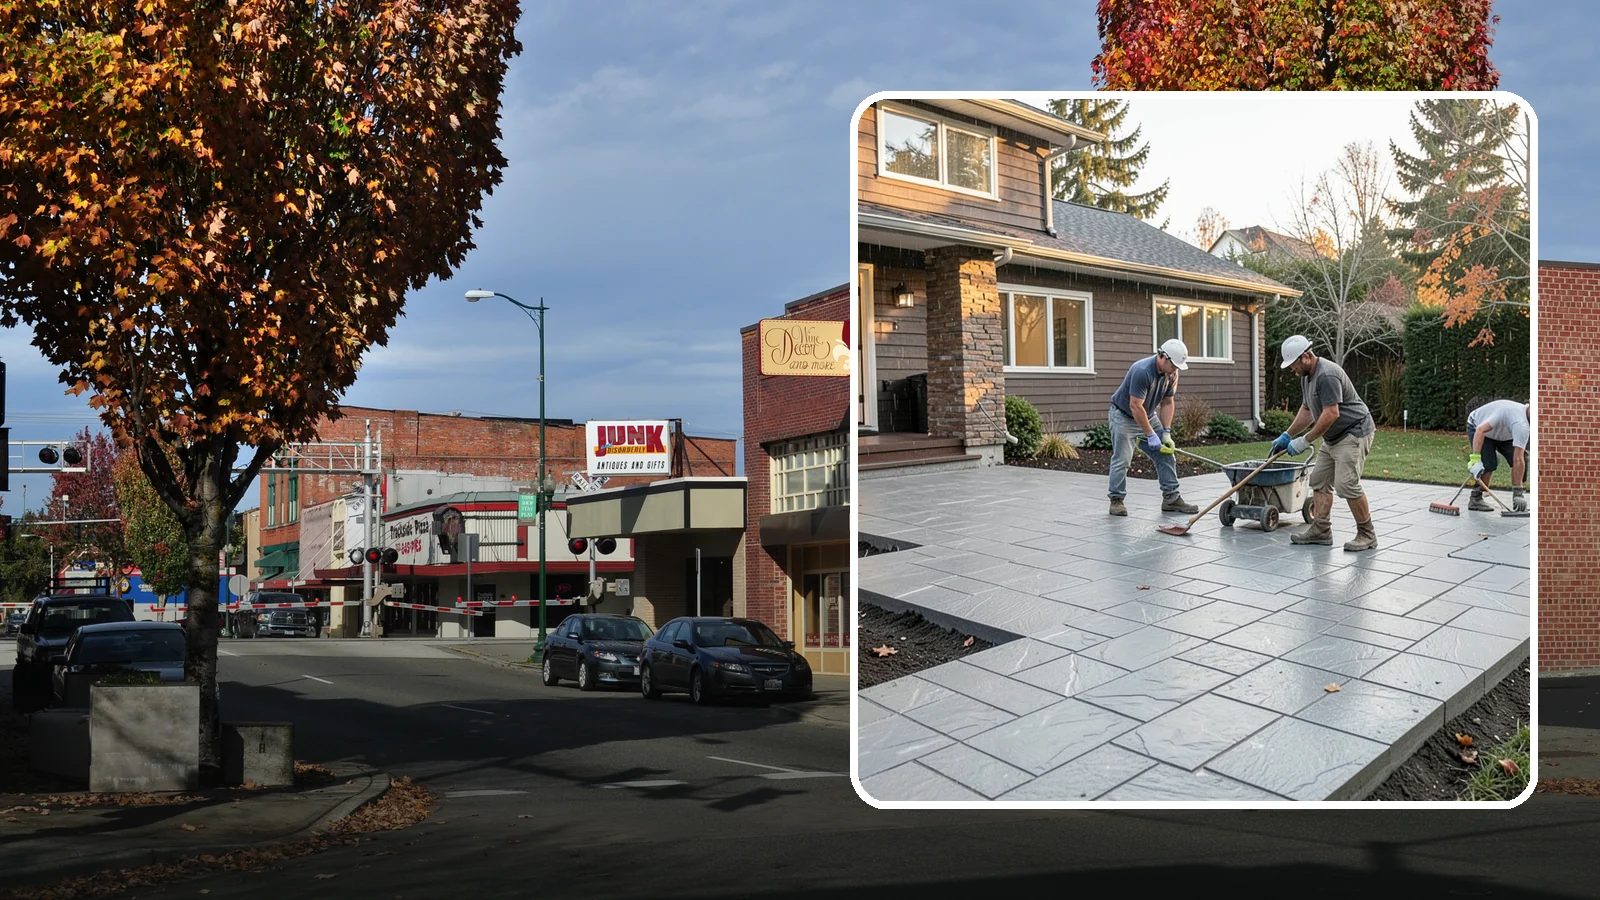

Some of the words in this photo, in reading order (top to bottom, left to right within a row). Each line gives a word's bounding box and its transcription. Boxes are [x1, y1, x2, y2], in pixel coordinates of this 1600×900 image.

[595, 425, 665, 457] JUNK
[607, 446, 645, 454] DISORDERLY
[596, 461, 628, 470] ANTIQUES
[631, 461, 644, 469] AND
[646, 460, 665, 469] GIFTS
[414, 519, 429, 535] Pizza
